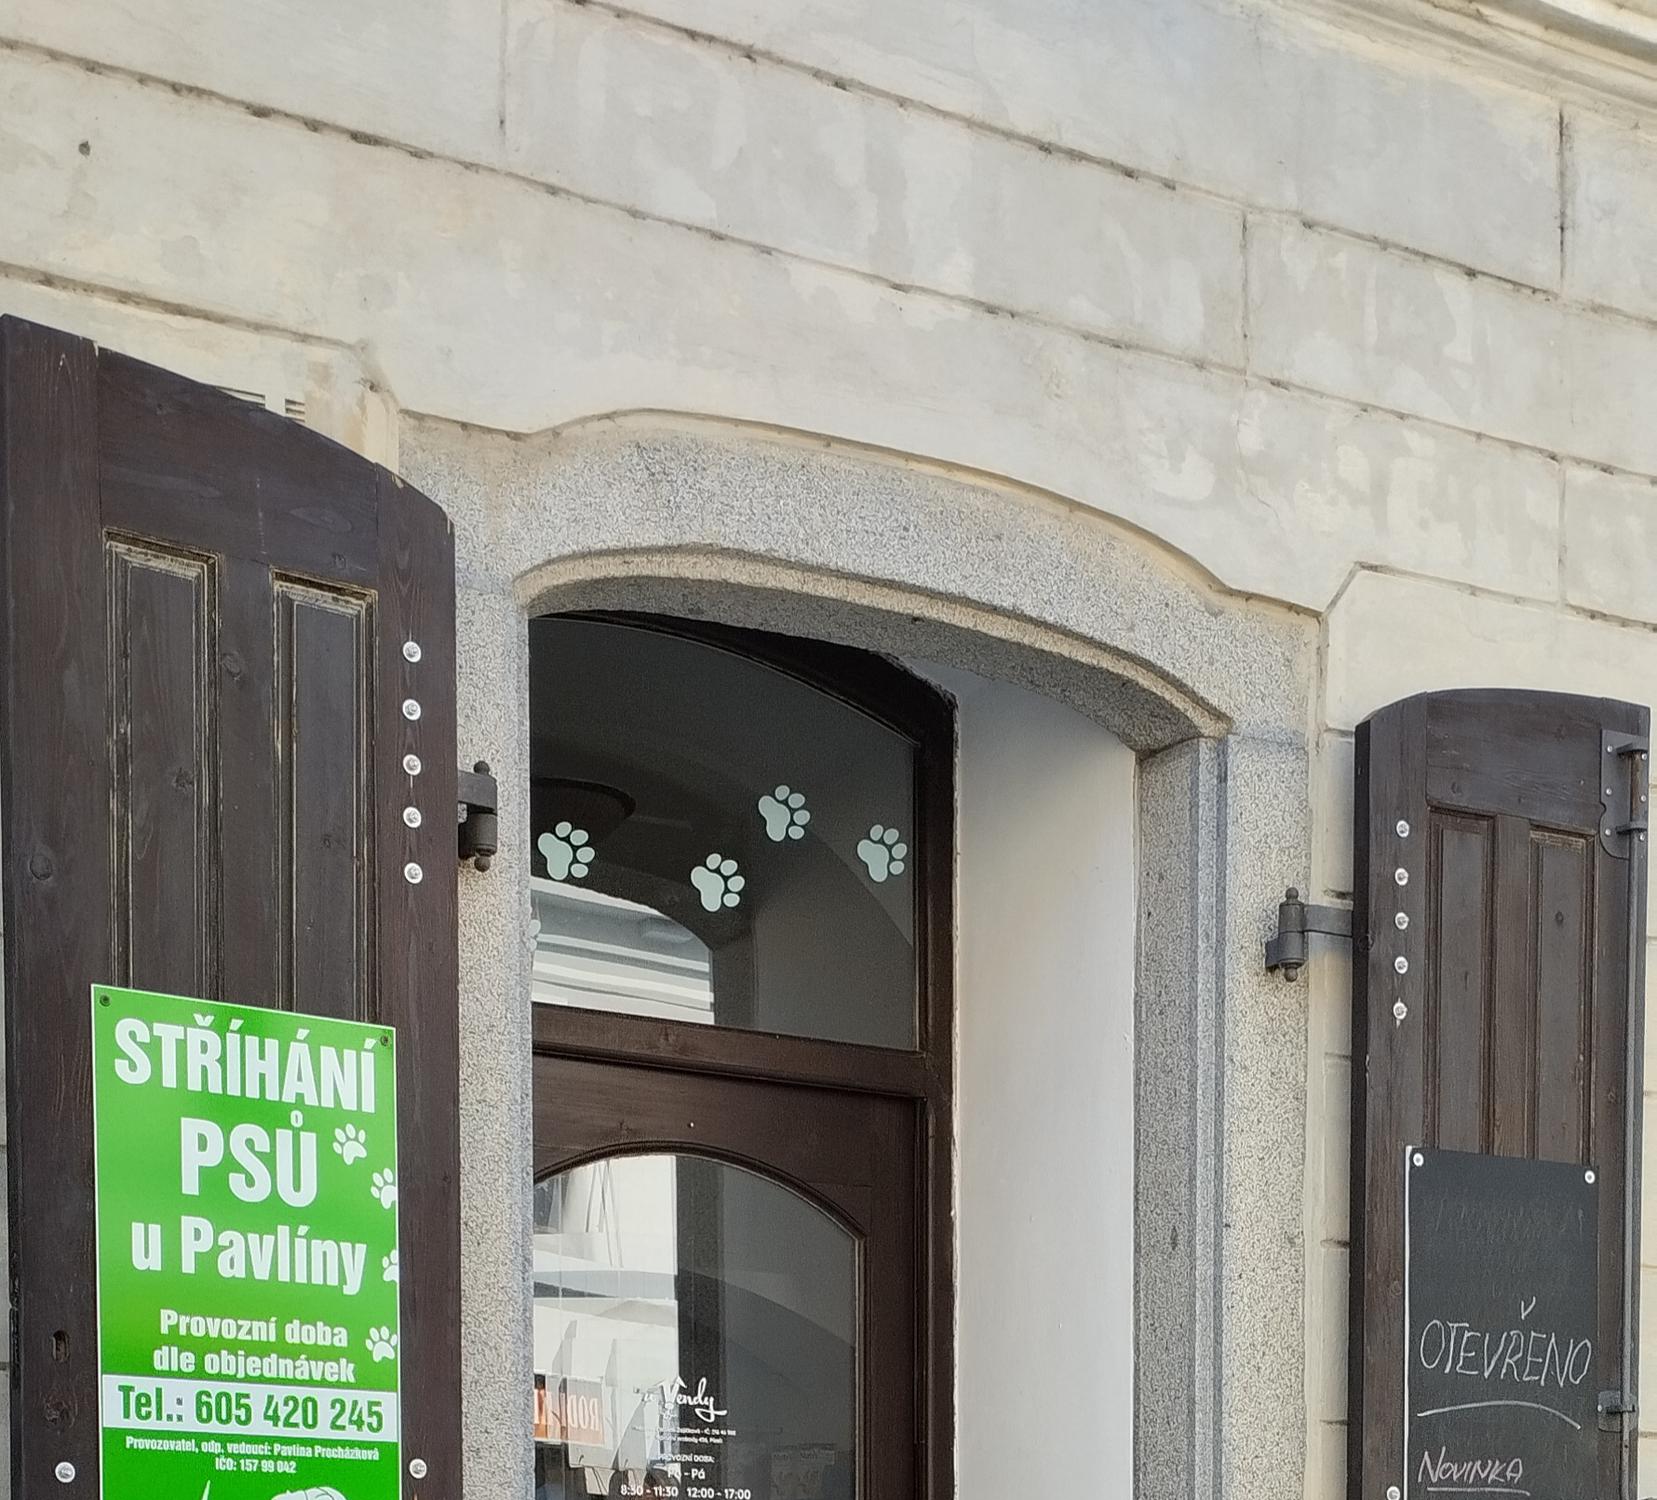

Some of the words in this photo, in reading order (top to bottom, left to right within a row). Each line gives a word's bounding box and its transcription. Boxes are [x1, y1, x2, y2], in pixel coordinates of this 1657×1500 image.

[114, 1013, 377, 1113] STŘÍHÁNÍ
[180, 1110, 317, 1207] PSŮ
[131, 1221, 162, 1271] u
[181, 1215, 367, 1295] Pavlíny
[159, 1309, 277, 1342] Provozní
[285, 1320, 348, 1347] doba
[1420, 1296, 1592, 1387] OTEVŘENO
[153, 1346, 196, 1372] dle
[204, 1350, 356, 1383] objednávek
[118, 1385, 183, 1423] Tel.:
[195, 1389, 251, 1426] 605
[263, 1394, 318, 1430] 420
[330, 1398, 384, 1434] 245
[201, 1440, 224, 1455] odp.
[227, 1441, 272, 1456] vedoucí:
[315, 1445, 380, 1461] Procházková
[215, 1455, 237, 1471] IČO:
[240, 1458, 259, 1472] 157
[261, 1460, 275, 1473] 99
[277, 1461, 297, 1473] 042
[653, 1485, 679, 1497] 11:30
[687, 1486, 714, 1498] 12:00
[724, 1488, 751, 1500] 17:00
[691, 1468, 706, 1480] Pá
